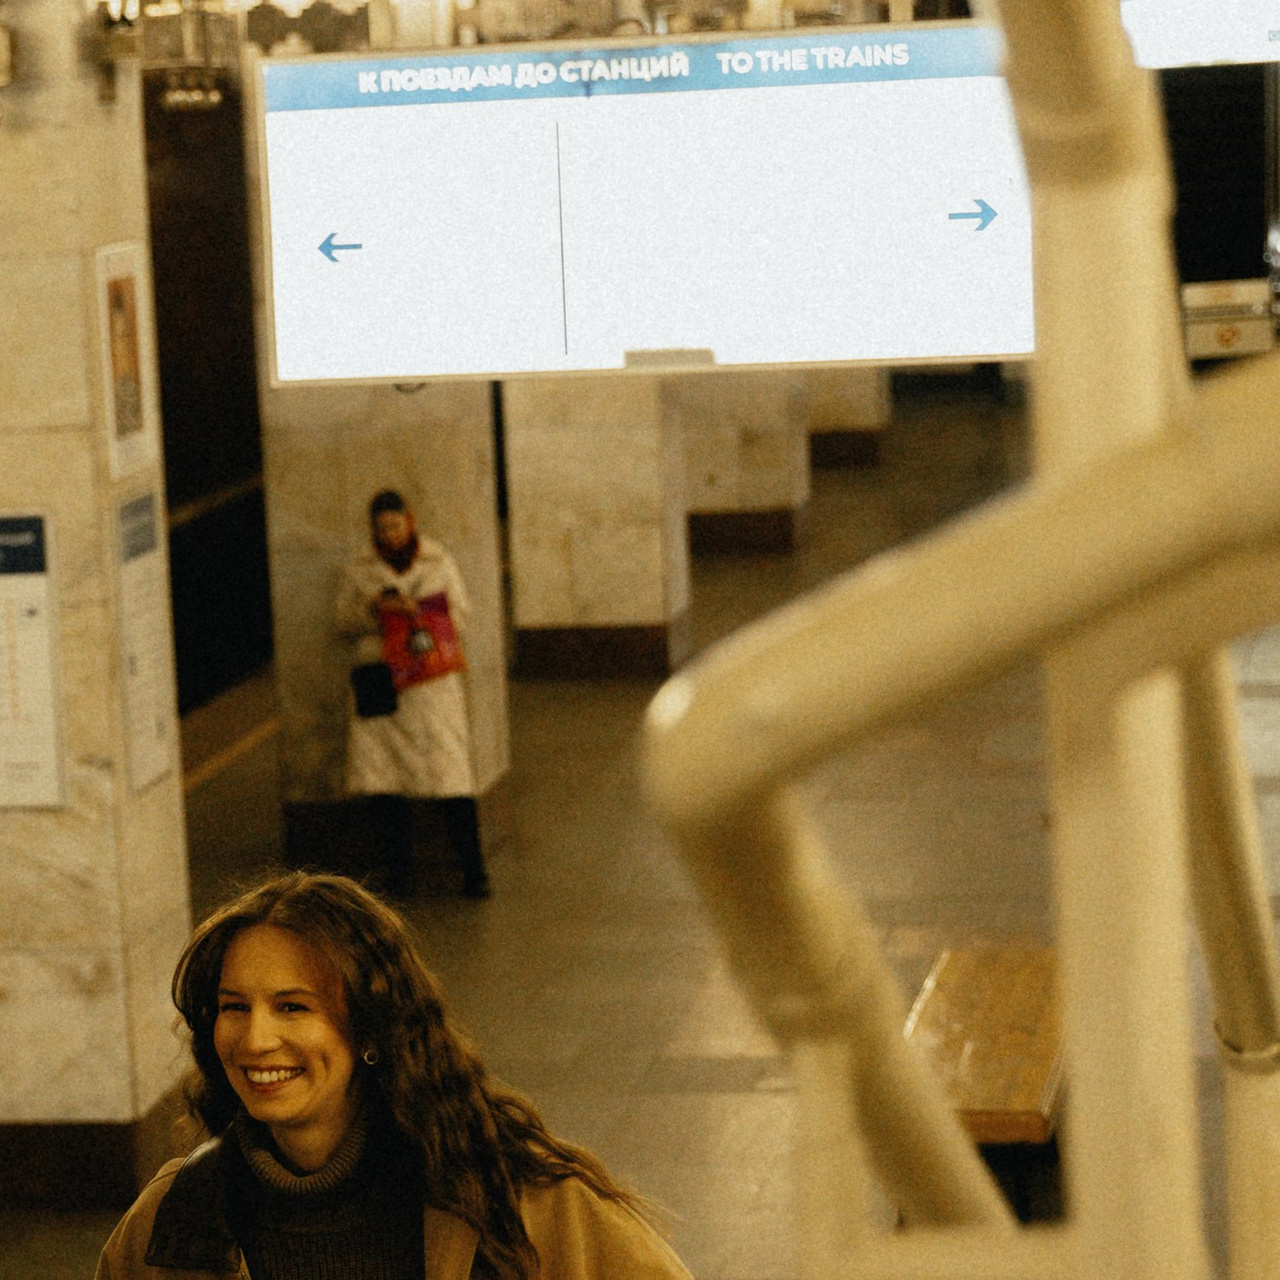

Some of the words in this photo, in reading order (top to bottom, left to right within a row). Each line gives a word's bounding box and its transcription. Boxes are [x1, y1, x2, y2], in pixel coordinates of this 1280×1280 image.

[358, 70, 379, 93] К
[380, 64, 512, 93] ПОЕЗДАМ
[514, 61, 557, 89] ДО
[559, 51, 689, 82] СТАНЦИЙ
[717, 52, 753, 74] TO
[756, 49, 808, 72] THE
[810, 44, 909, 69] TRAINS
